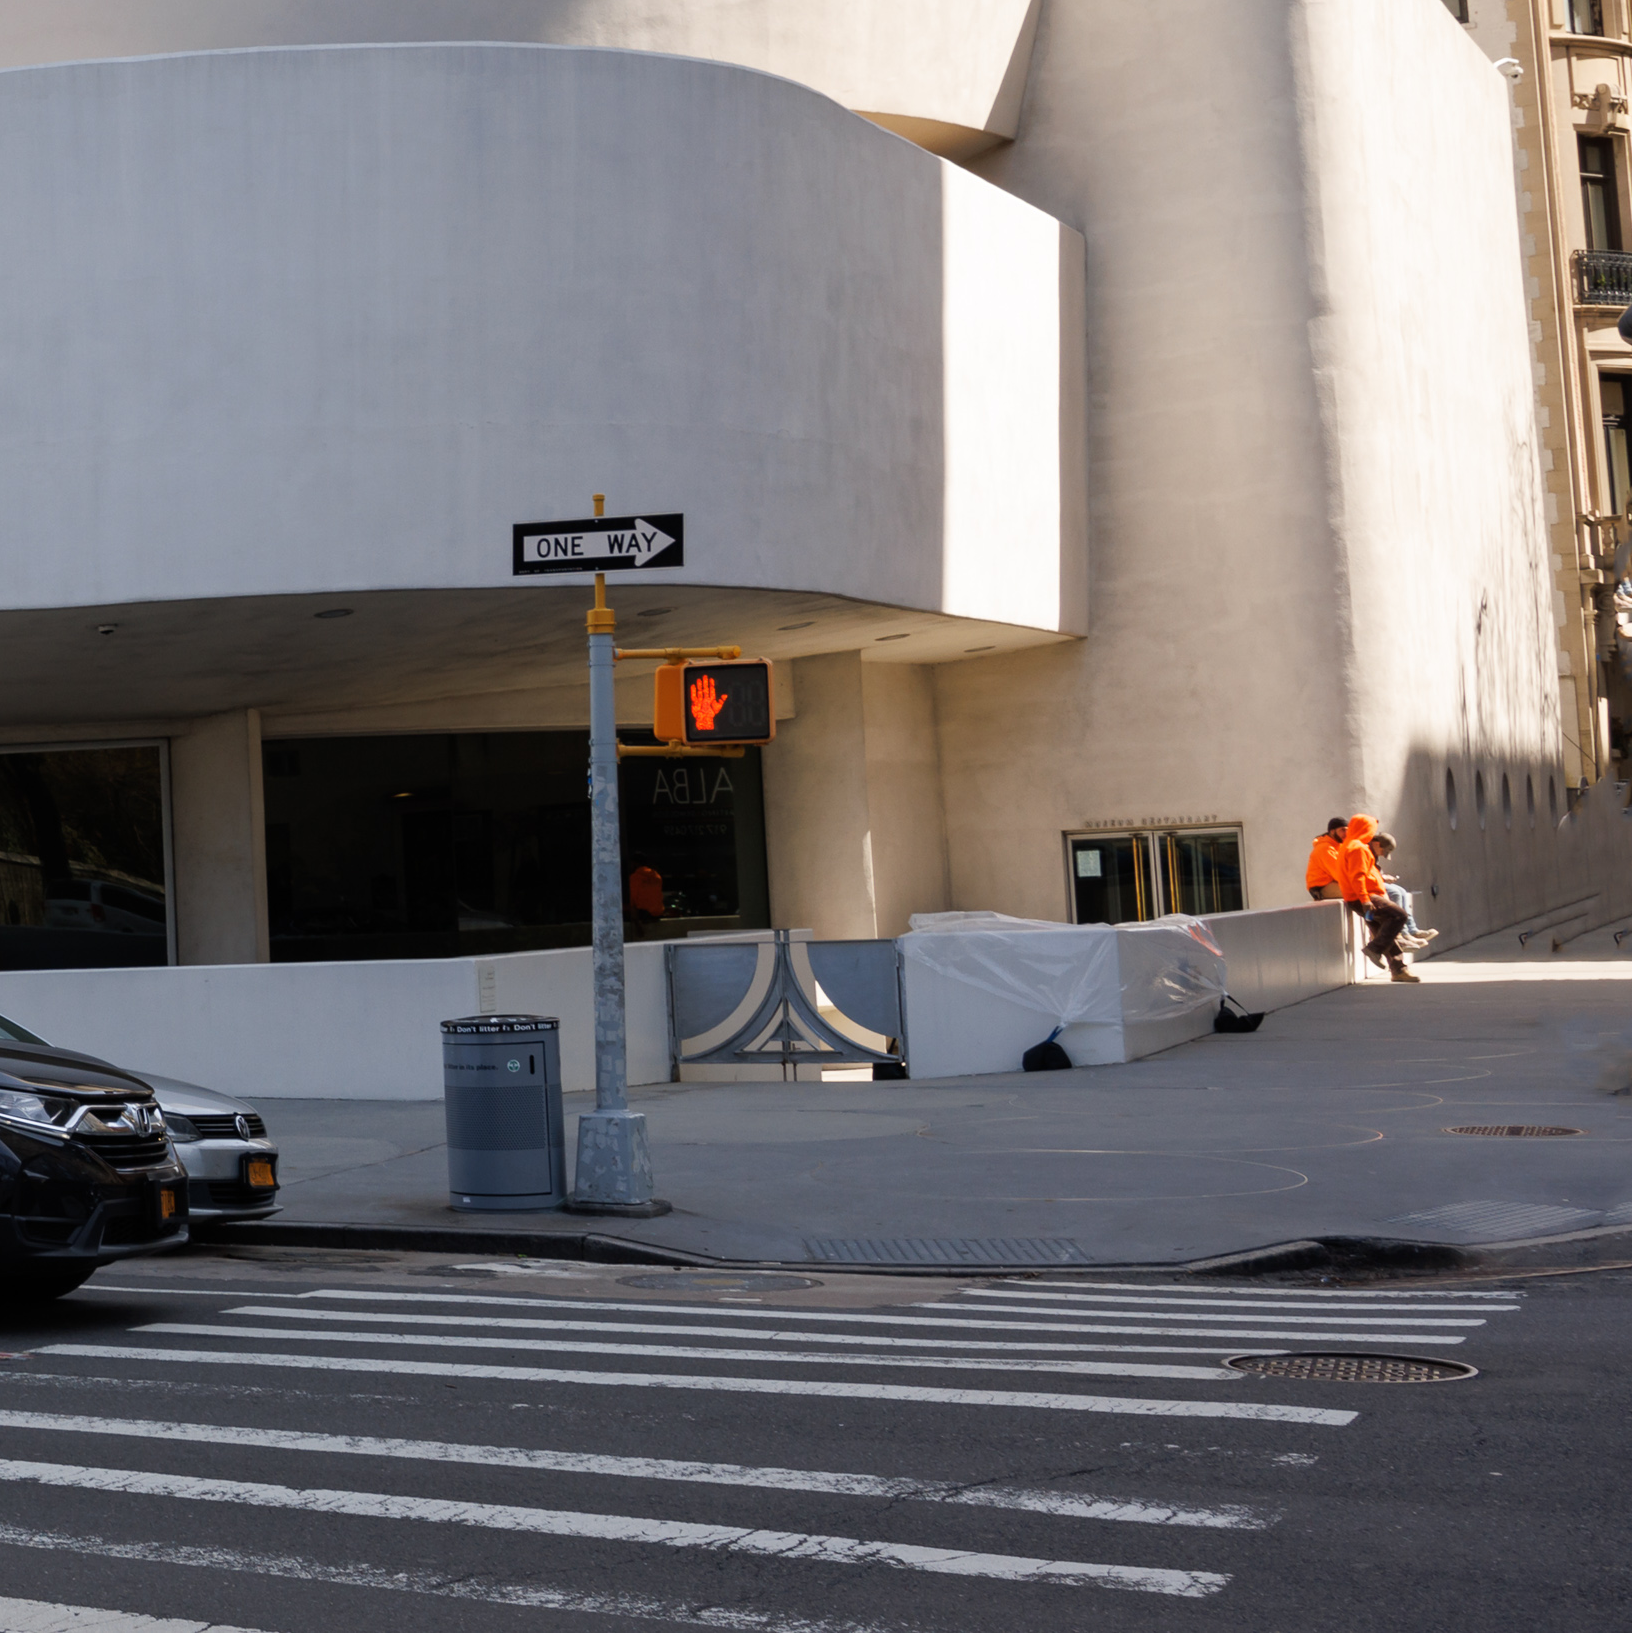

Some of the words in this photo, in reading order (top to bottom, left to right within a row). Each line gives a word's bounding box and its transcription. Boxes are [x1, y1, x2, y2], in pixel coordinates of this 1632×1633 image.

[537, 536, 583, 558] ONE
[607, 532, 657, 554] WAY
[514, 1023, 536, 1031] Don't
